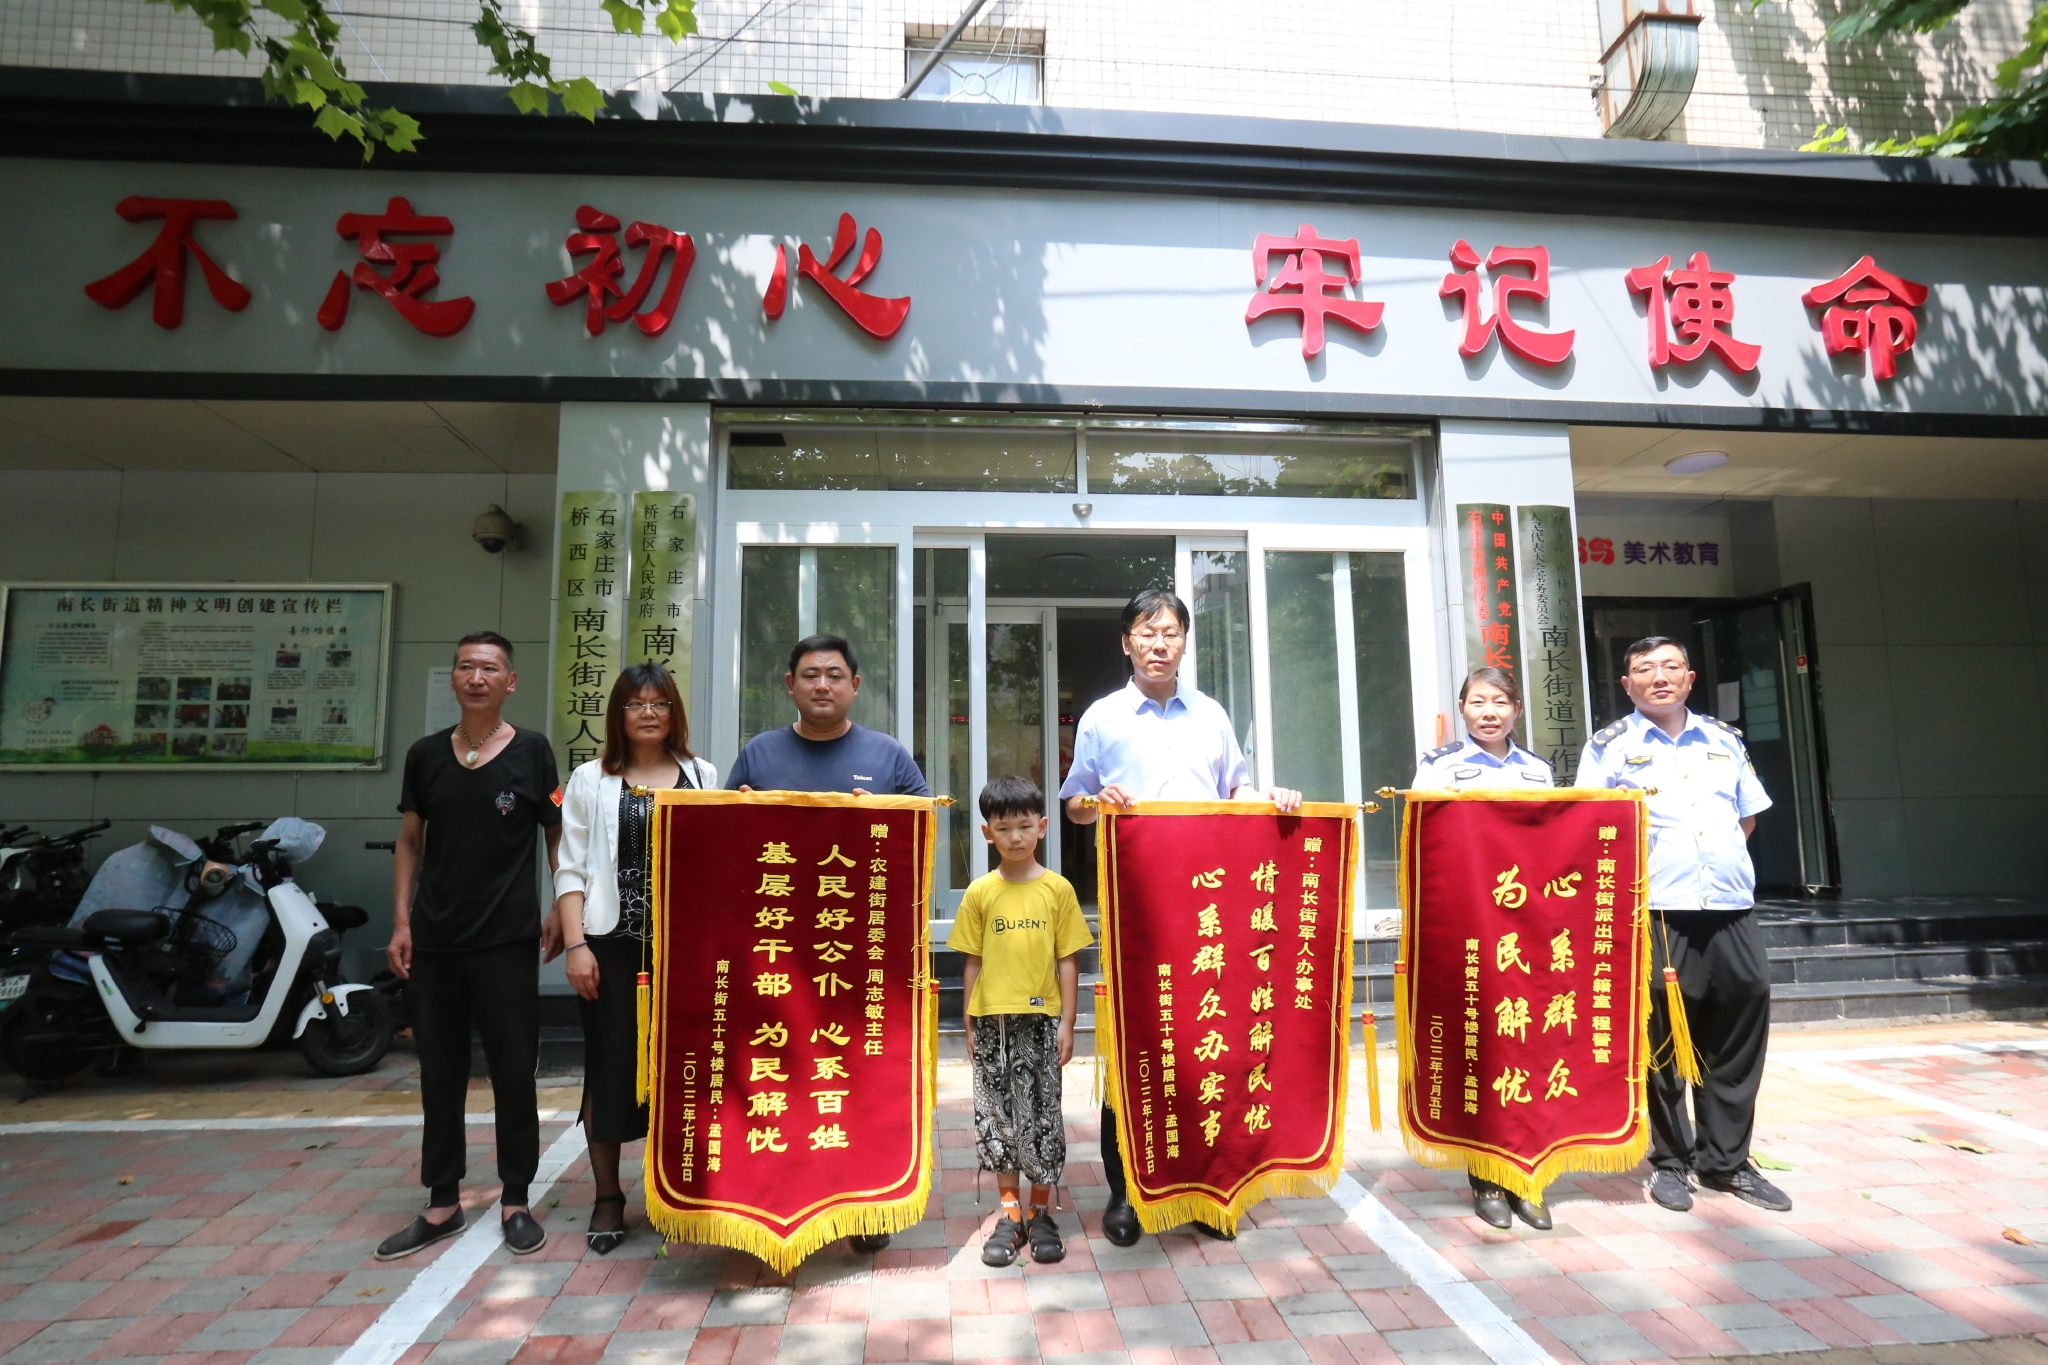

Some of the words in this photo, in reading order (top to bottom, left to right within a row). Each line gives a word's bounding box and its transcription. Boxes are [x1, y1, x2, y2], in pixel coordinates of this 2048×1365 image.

[84, 195, 911, 341] 不忘初心
[1245, 223, 1928, 382] 牢记使命
[57, 596, 343, 614] 南长街道精神文明创建宣传栏
[567, 507, 590, 597] 桥西区
[593, 508, 617, 597] 石家庄市
[639, 503, 659, 618] 桥西区人民政府
[666, 504, 686, 618] 石家庄市
[1491, 510, 1512, 617] 中国共产党
[1531, 512, 1549, 624] 人民代表大会常务委员会
[1623, 541, 1719, 565] 美术教育
[565, 608, 608, 783] 南长街道人民
[641, 624, 678, 674] 南
[1479, 621, 1514, 677] 南长
[752, 841, 797, 997] 基层好干部
[812, 844, 856, 997] 人民好公仆
[867, 824, 888, 961] 赠：农建街居委会
[1294, 837, 1322, 1010] 赠：南长街军人办事处
[1593, 826, 1617, 955] 赠：南长街派出所
[864, 969, 885, 1056] 周志敏主任
[1192, 867, 1229, 1148] 心系群众办实事
[1244, 860, 1279, 1134] 情暖百姓解民忧
[1464, 938, 1479, 1114] 南长街五十号楼居民：孟国海
[1492, 864, 1533, 1107] 为民解忧
[1542, 871, 1582, 1102] 心系群众
[1592, 1016, 1612, 1063] 程警官
[1593, 962, 1612, 1009] 户籍室
[706, 959, 730, 1173] 南长街五十号楼居民：孟国海
[746, 1022, 789, 1153] 为民解忧
[808, 1022, 850, 1150] 心系百姓
[1157, 964, 1179, 1158] 南长街五十号楼居民：孟国海
